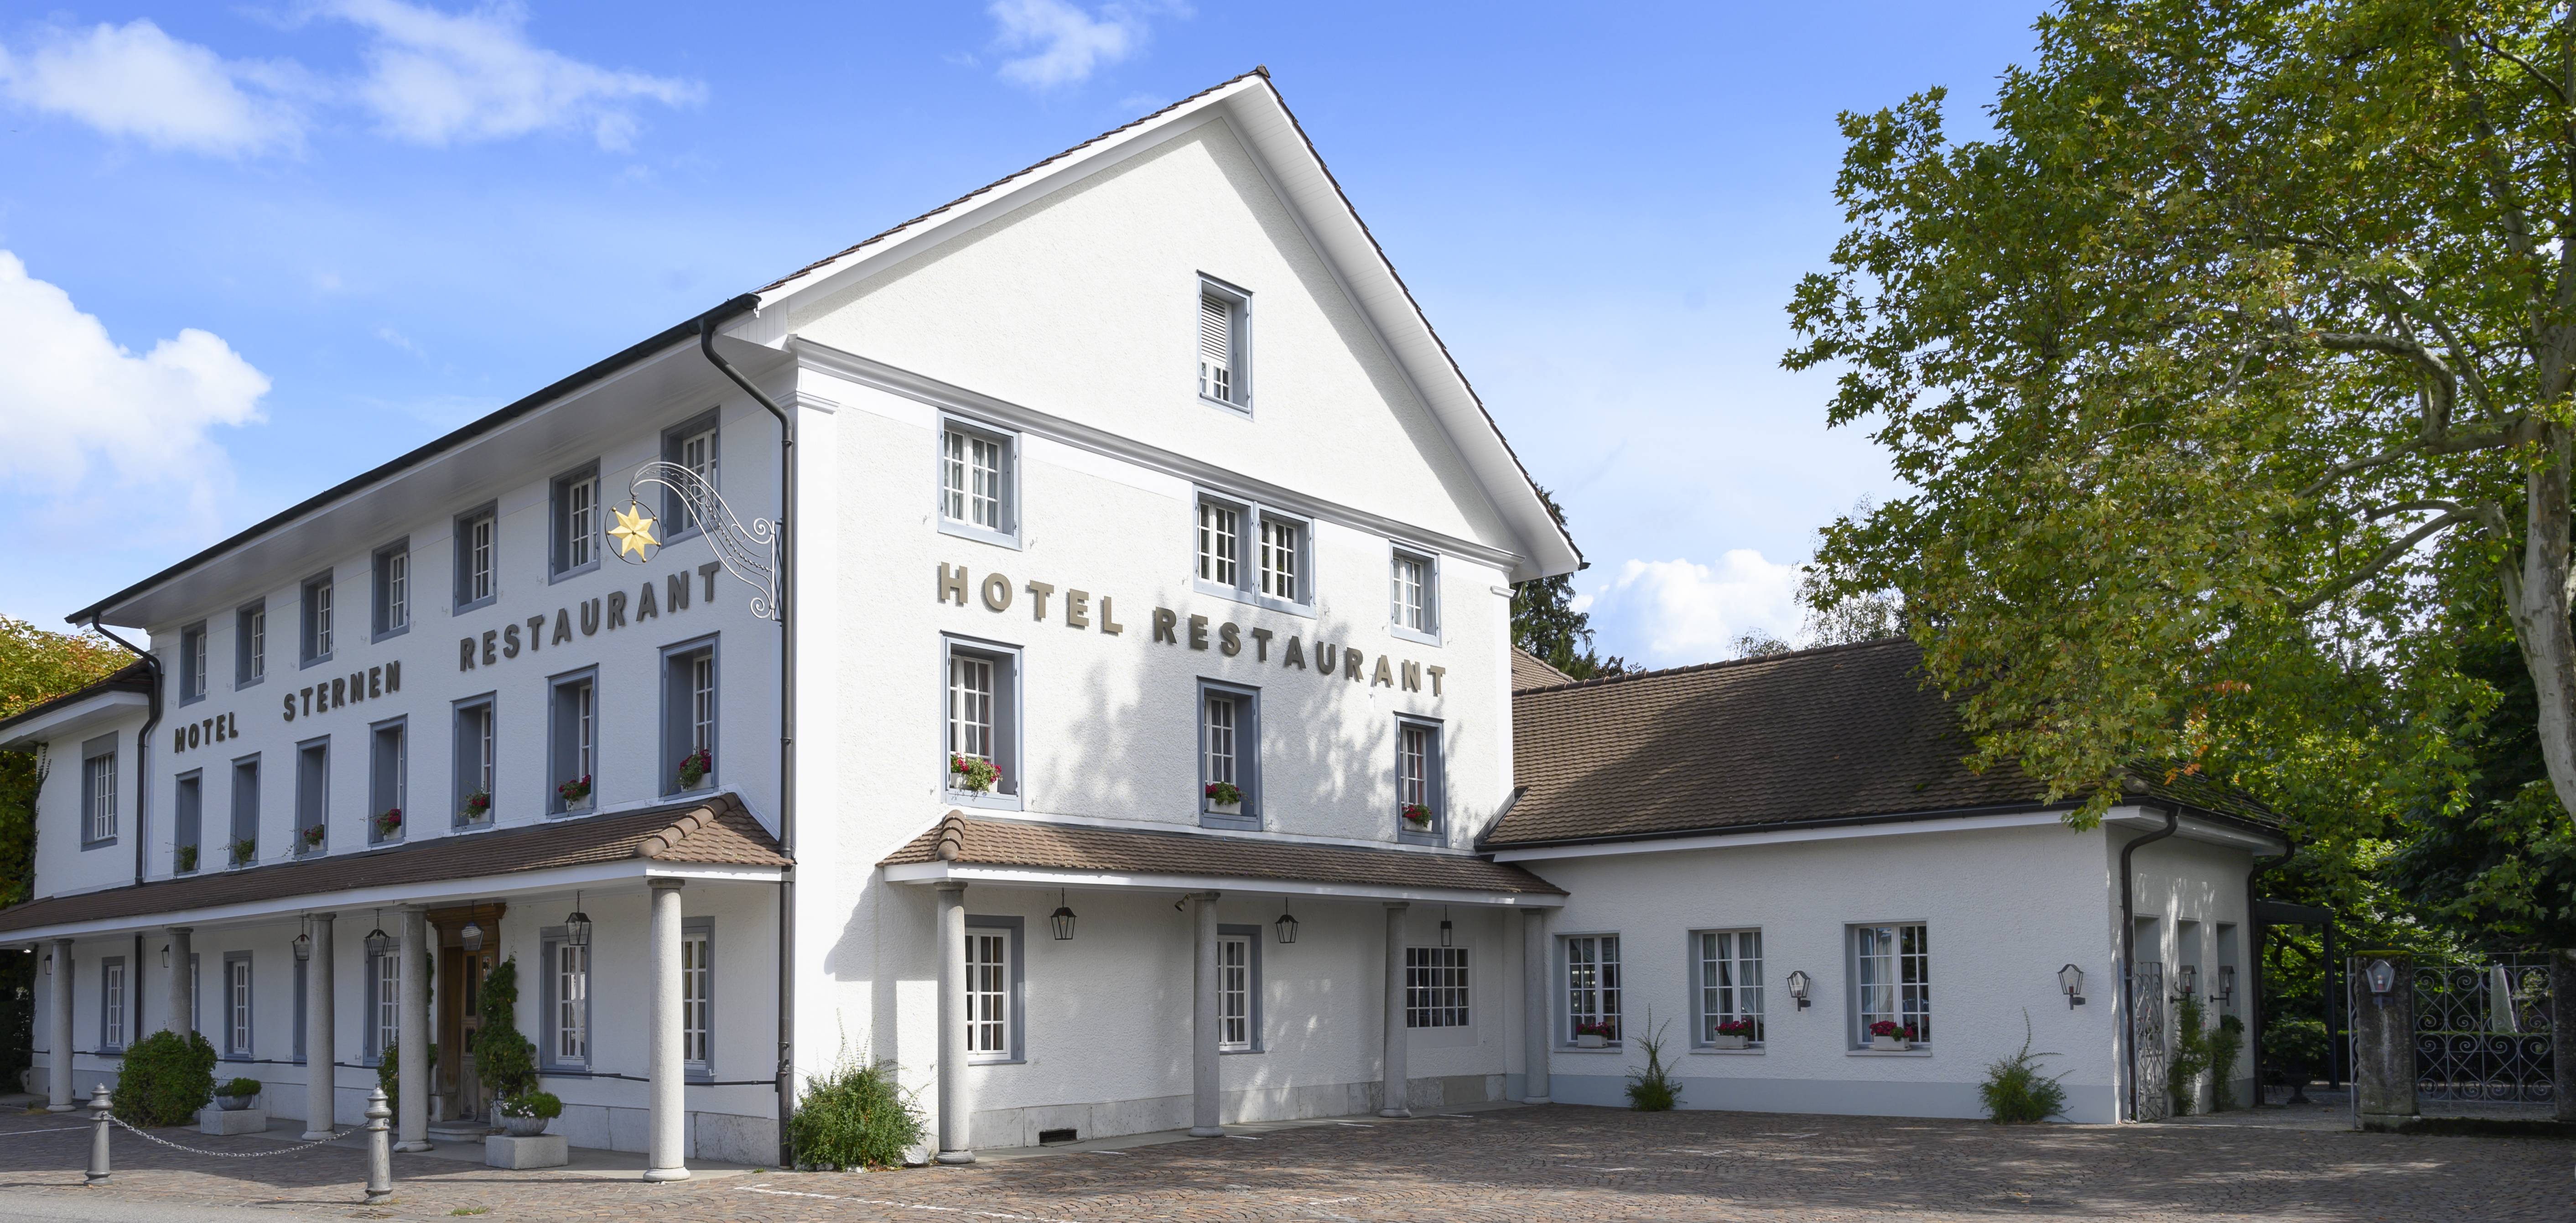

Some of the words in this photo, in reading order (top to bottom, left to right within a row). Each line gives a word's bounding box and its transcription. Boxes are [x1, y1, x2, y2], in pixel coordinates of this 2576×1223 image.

[174, 712, 239, 754] HOTEL
[283, 660, 400, 722] STERNEN
[460, 561, 719, 671] RESTAURANT
[940, 562, 1123, 633] HOTEL
[1154, 606, 1446, 695] RESTAURANT
